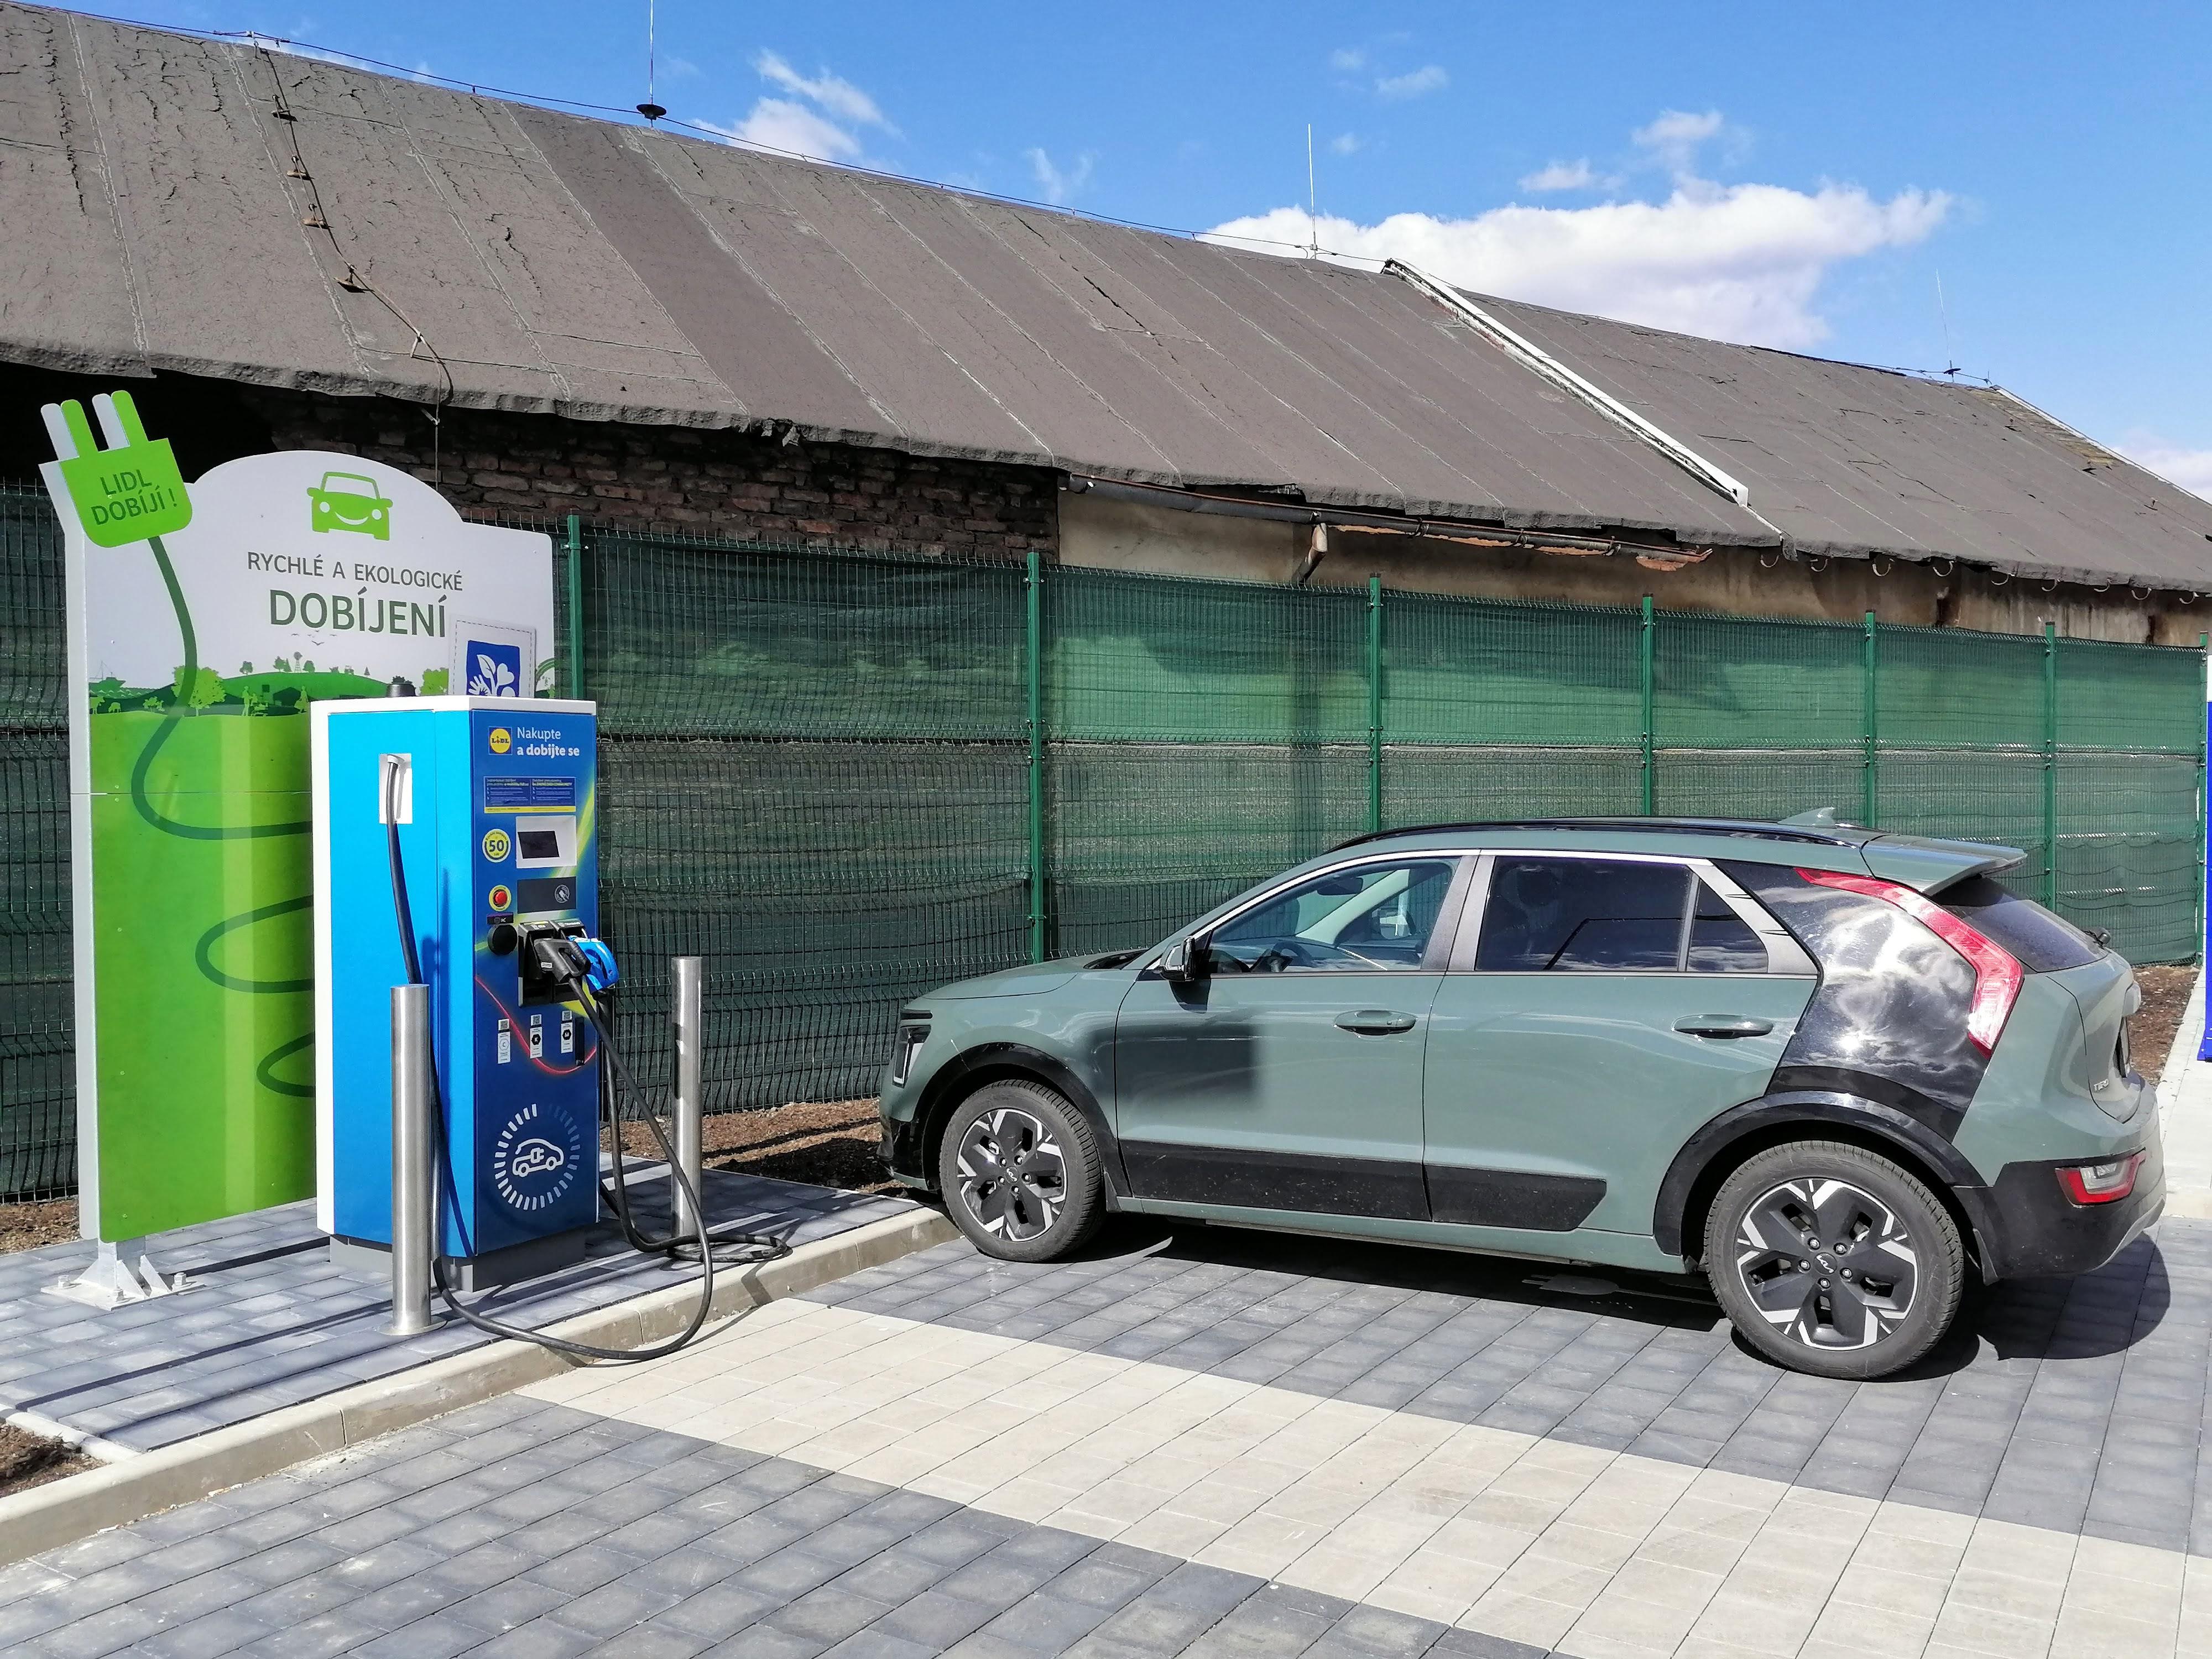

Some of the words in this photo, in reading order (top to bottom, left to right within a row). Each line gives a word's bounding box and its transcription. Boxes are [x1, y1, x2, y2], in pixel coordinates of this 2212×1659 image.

[100, 469, 153, 495] LIDL
[91, 484, 165, 525] DOBÍJÍ
[247, 551, 324, 577] RYCHLÉ
[332, 561, 346, 579] A
[354, 563, 463, 591] EKOLOGICKÉ
[270, 586, 447, 638] DOBÍJENÍ
[517, 727, 561, 742] Nakupte
[517, 746, 524, 755] a
[526, 743, 566, 759] dobijte
[568, 747, 580, 757] se
[489, 839, 504, 852] 50
